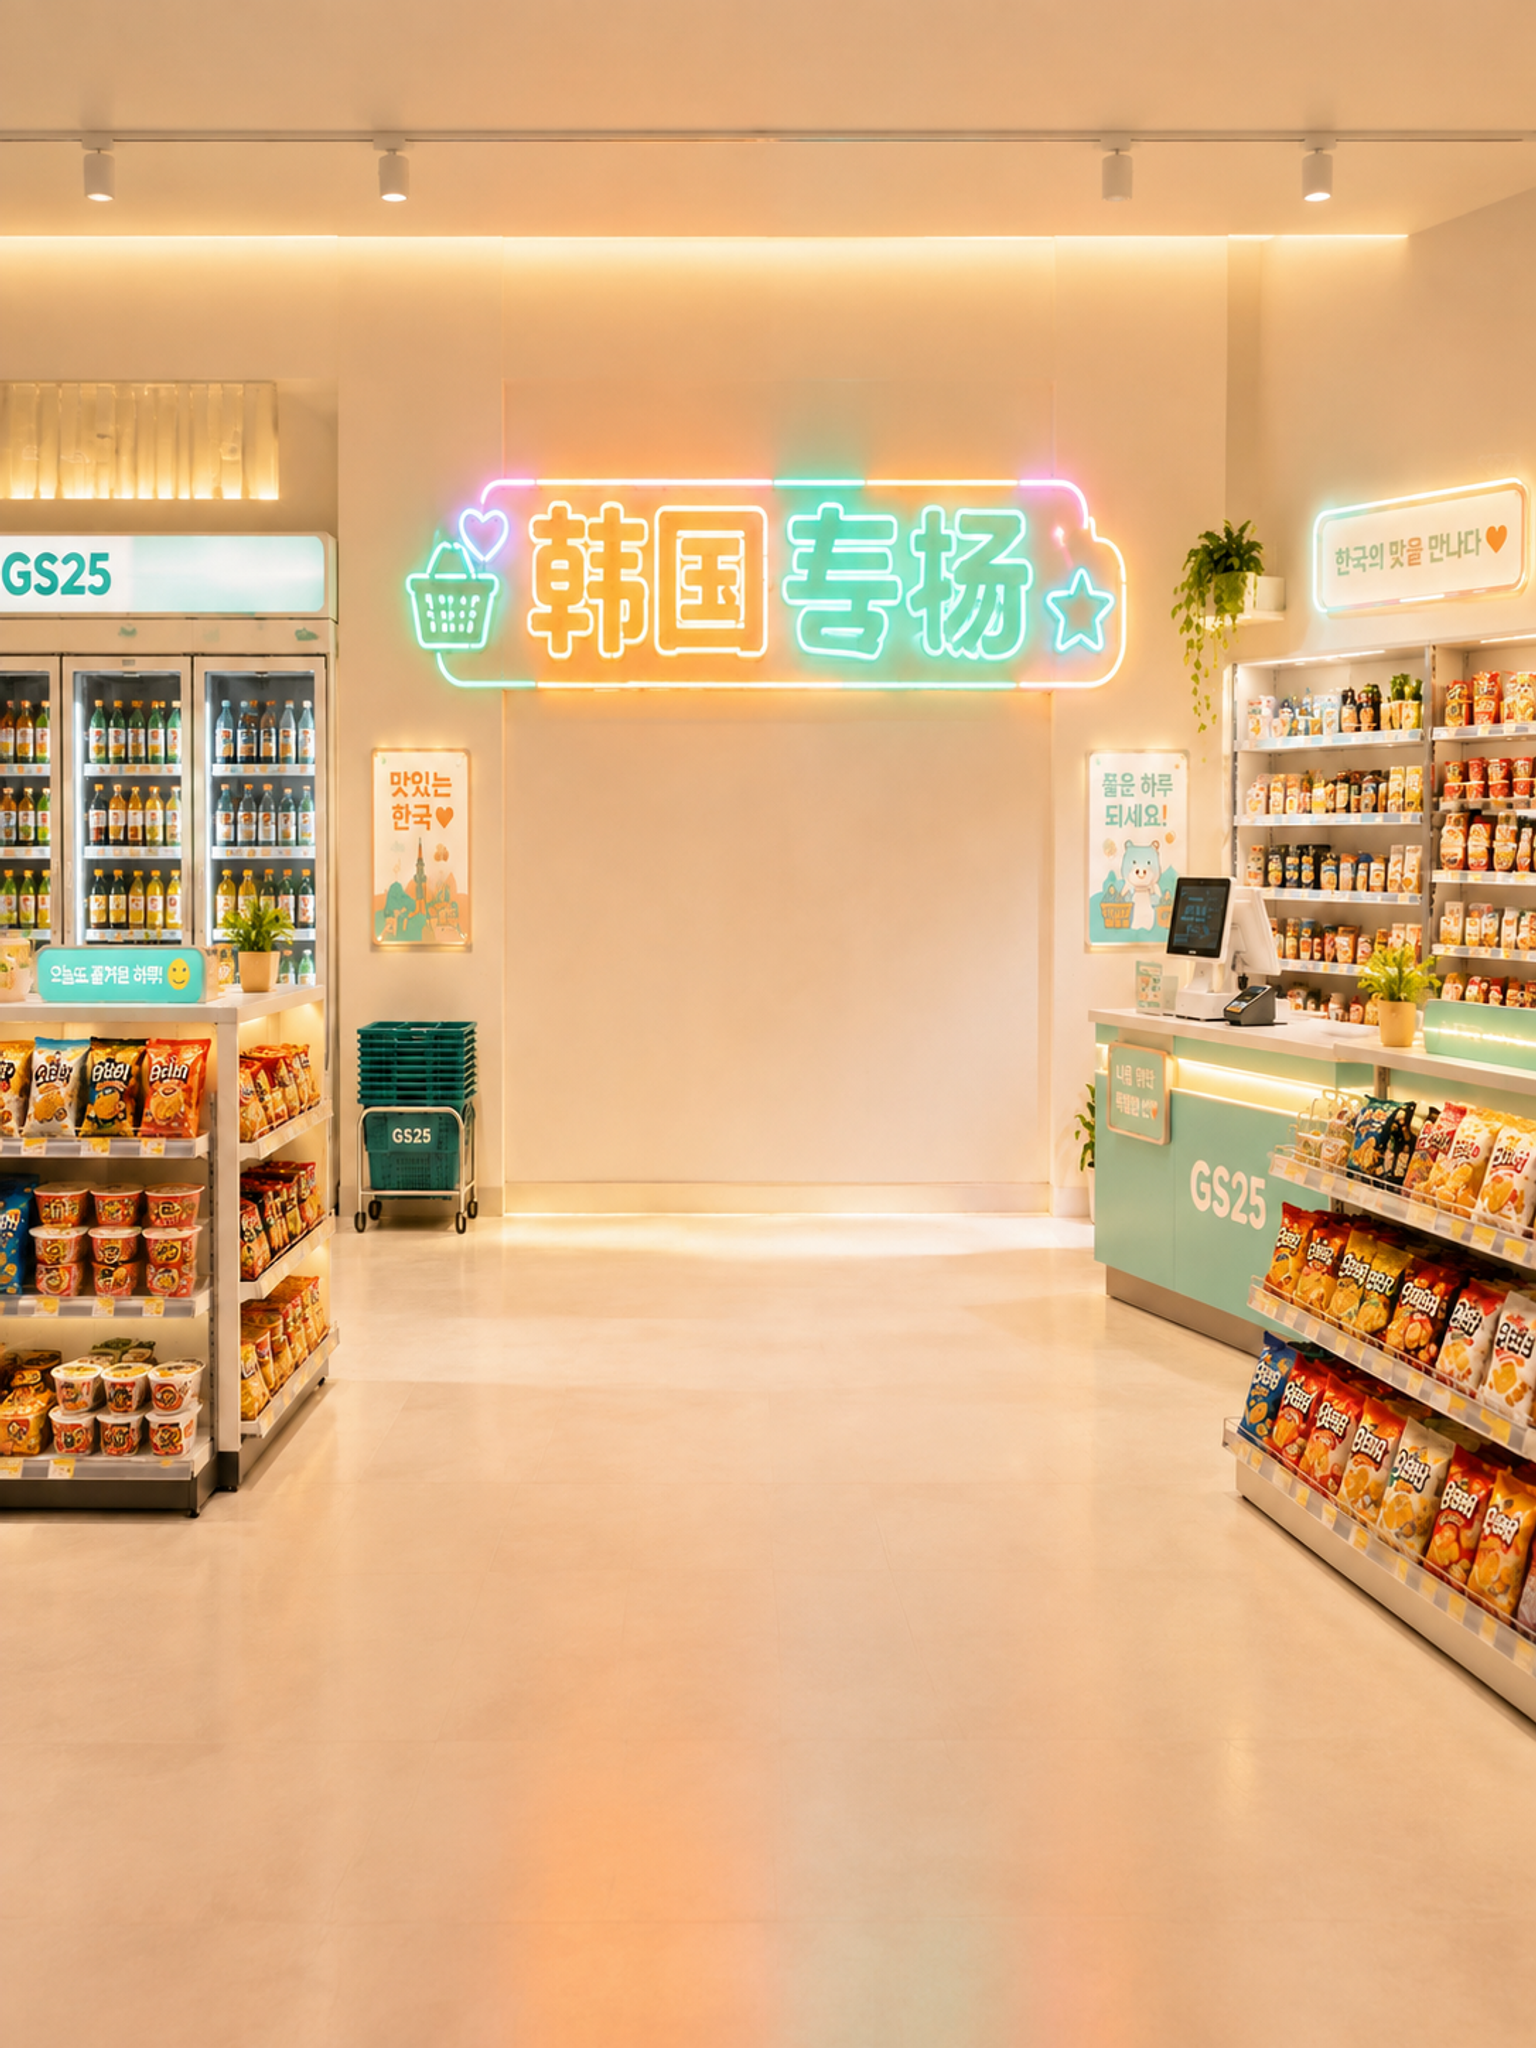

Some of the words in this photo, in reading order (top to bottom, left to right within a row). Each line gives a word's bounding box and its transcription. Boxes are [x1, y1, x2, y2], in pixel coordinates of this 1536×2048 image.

[1335, 542, 1384, 577] 한국의
[1389, 536, 1424, 569] 맛을
[1428, 528, 1482, 564] 만나다
[1, 551, 111, 596] GS25
[390, 770, 452, 797] 맛있는
[1140, 772, 1174, 798] 하루
[391, 803, 432, 831] 한국
[1105, 803, 1167, 828] 되세요!
[391, 1128, 431, 1144] GS25
[1190, 1159, 1267, 1230] GS25
